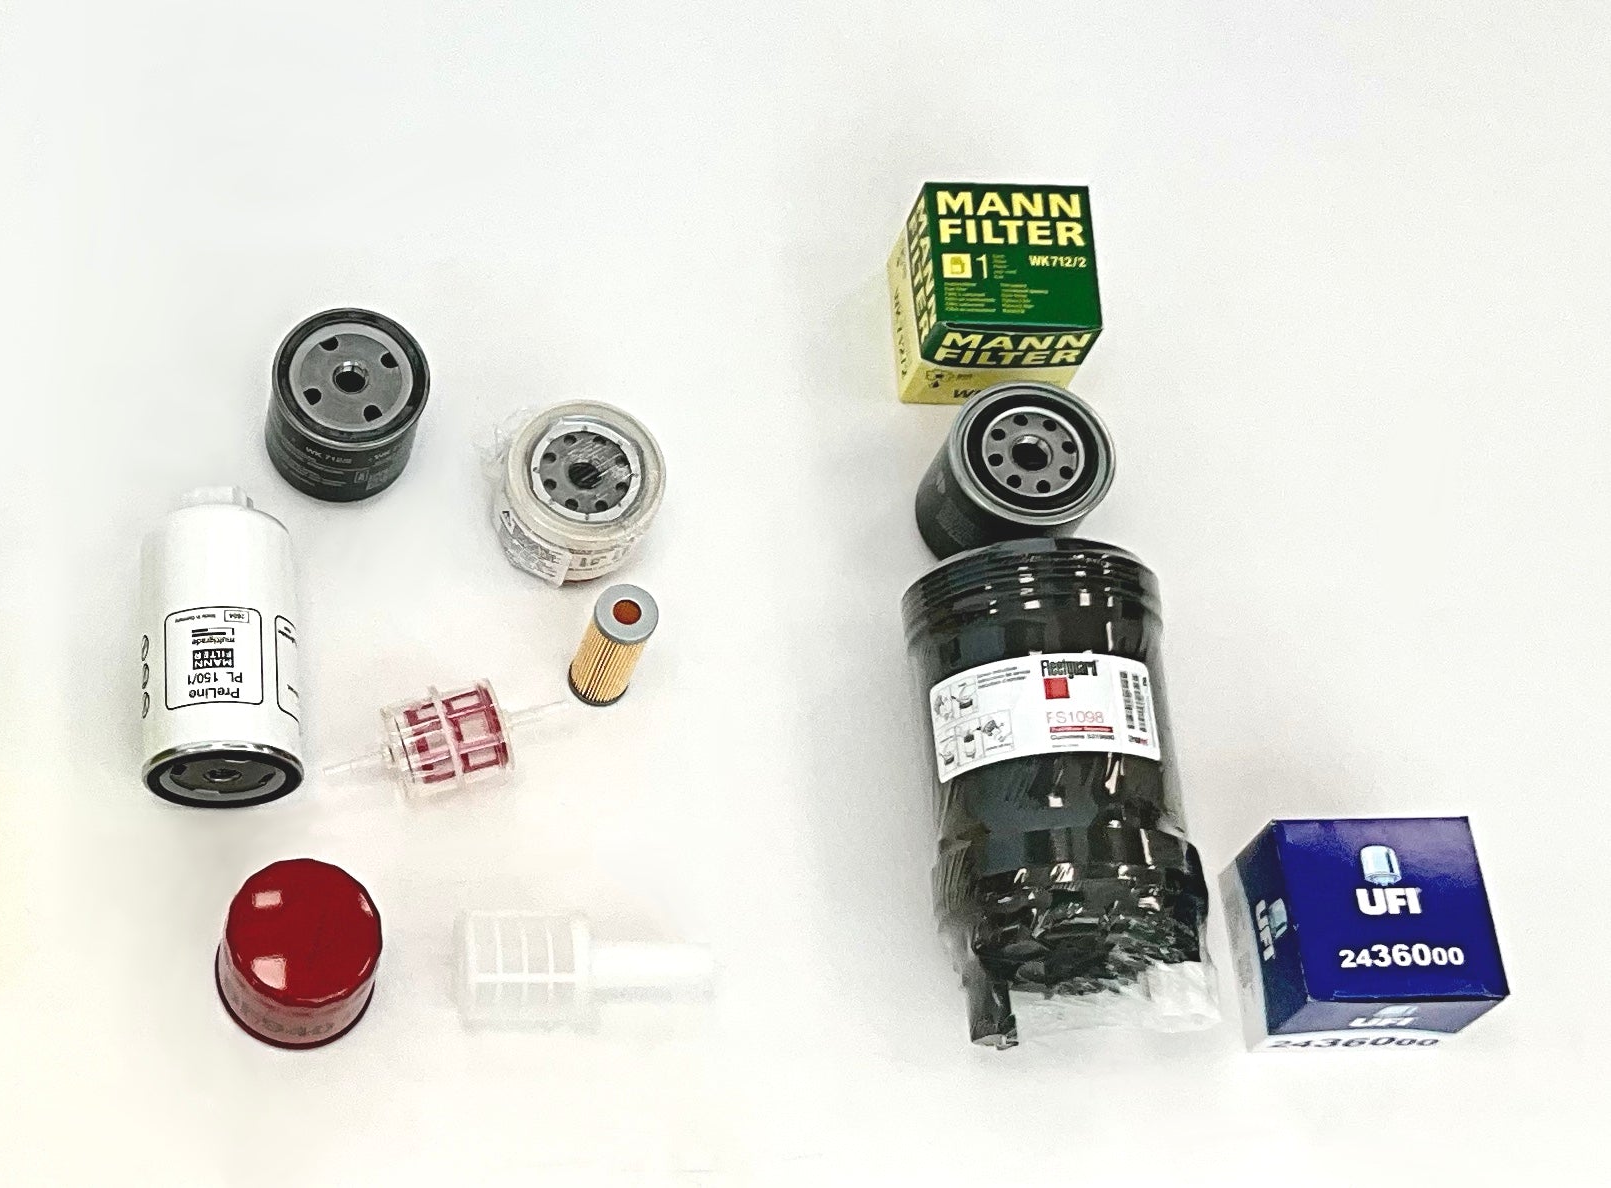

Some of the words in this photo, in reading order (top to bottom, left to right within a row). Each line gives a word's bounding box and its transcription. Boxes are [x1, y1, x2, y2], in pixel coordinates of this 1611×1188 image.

[936, 190, 1082, 218] MANN
[939, 218, 1087, 246] FILTER
[975, 253, 988, 279] 1
[1028, 255, 1049, 266] WK
[941, 332, 1092, 350] MANN
[933, 347, 1082, 366] FILTER
[193, 650, 232, 660] FILTER
[194, 659, 233, 669] MANN
[187, 671, 219, 685] 150/1
[226, 671, 243, 683] PL
[189, 686, 240, 699] PreLine
[1045, 711, 1105, 724] FS1098
[1355, 887, 1422, 916] UFI
[1339, 943, 1465, 968] 2436000
[1348, 1016, 1416, 1028] UFI
